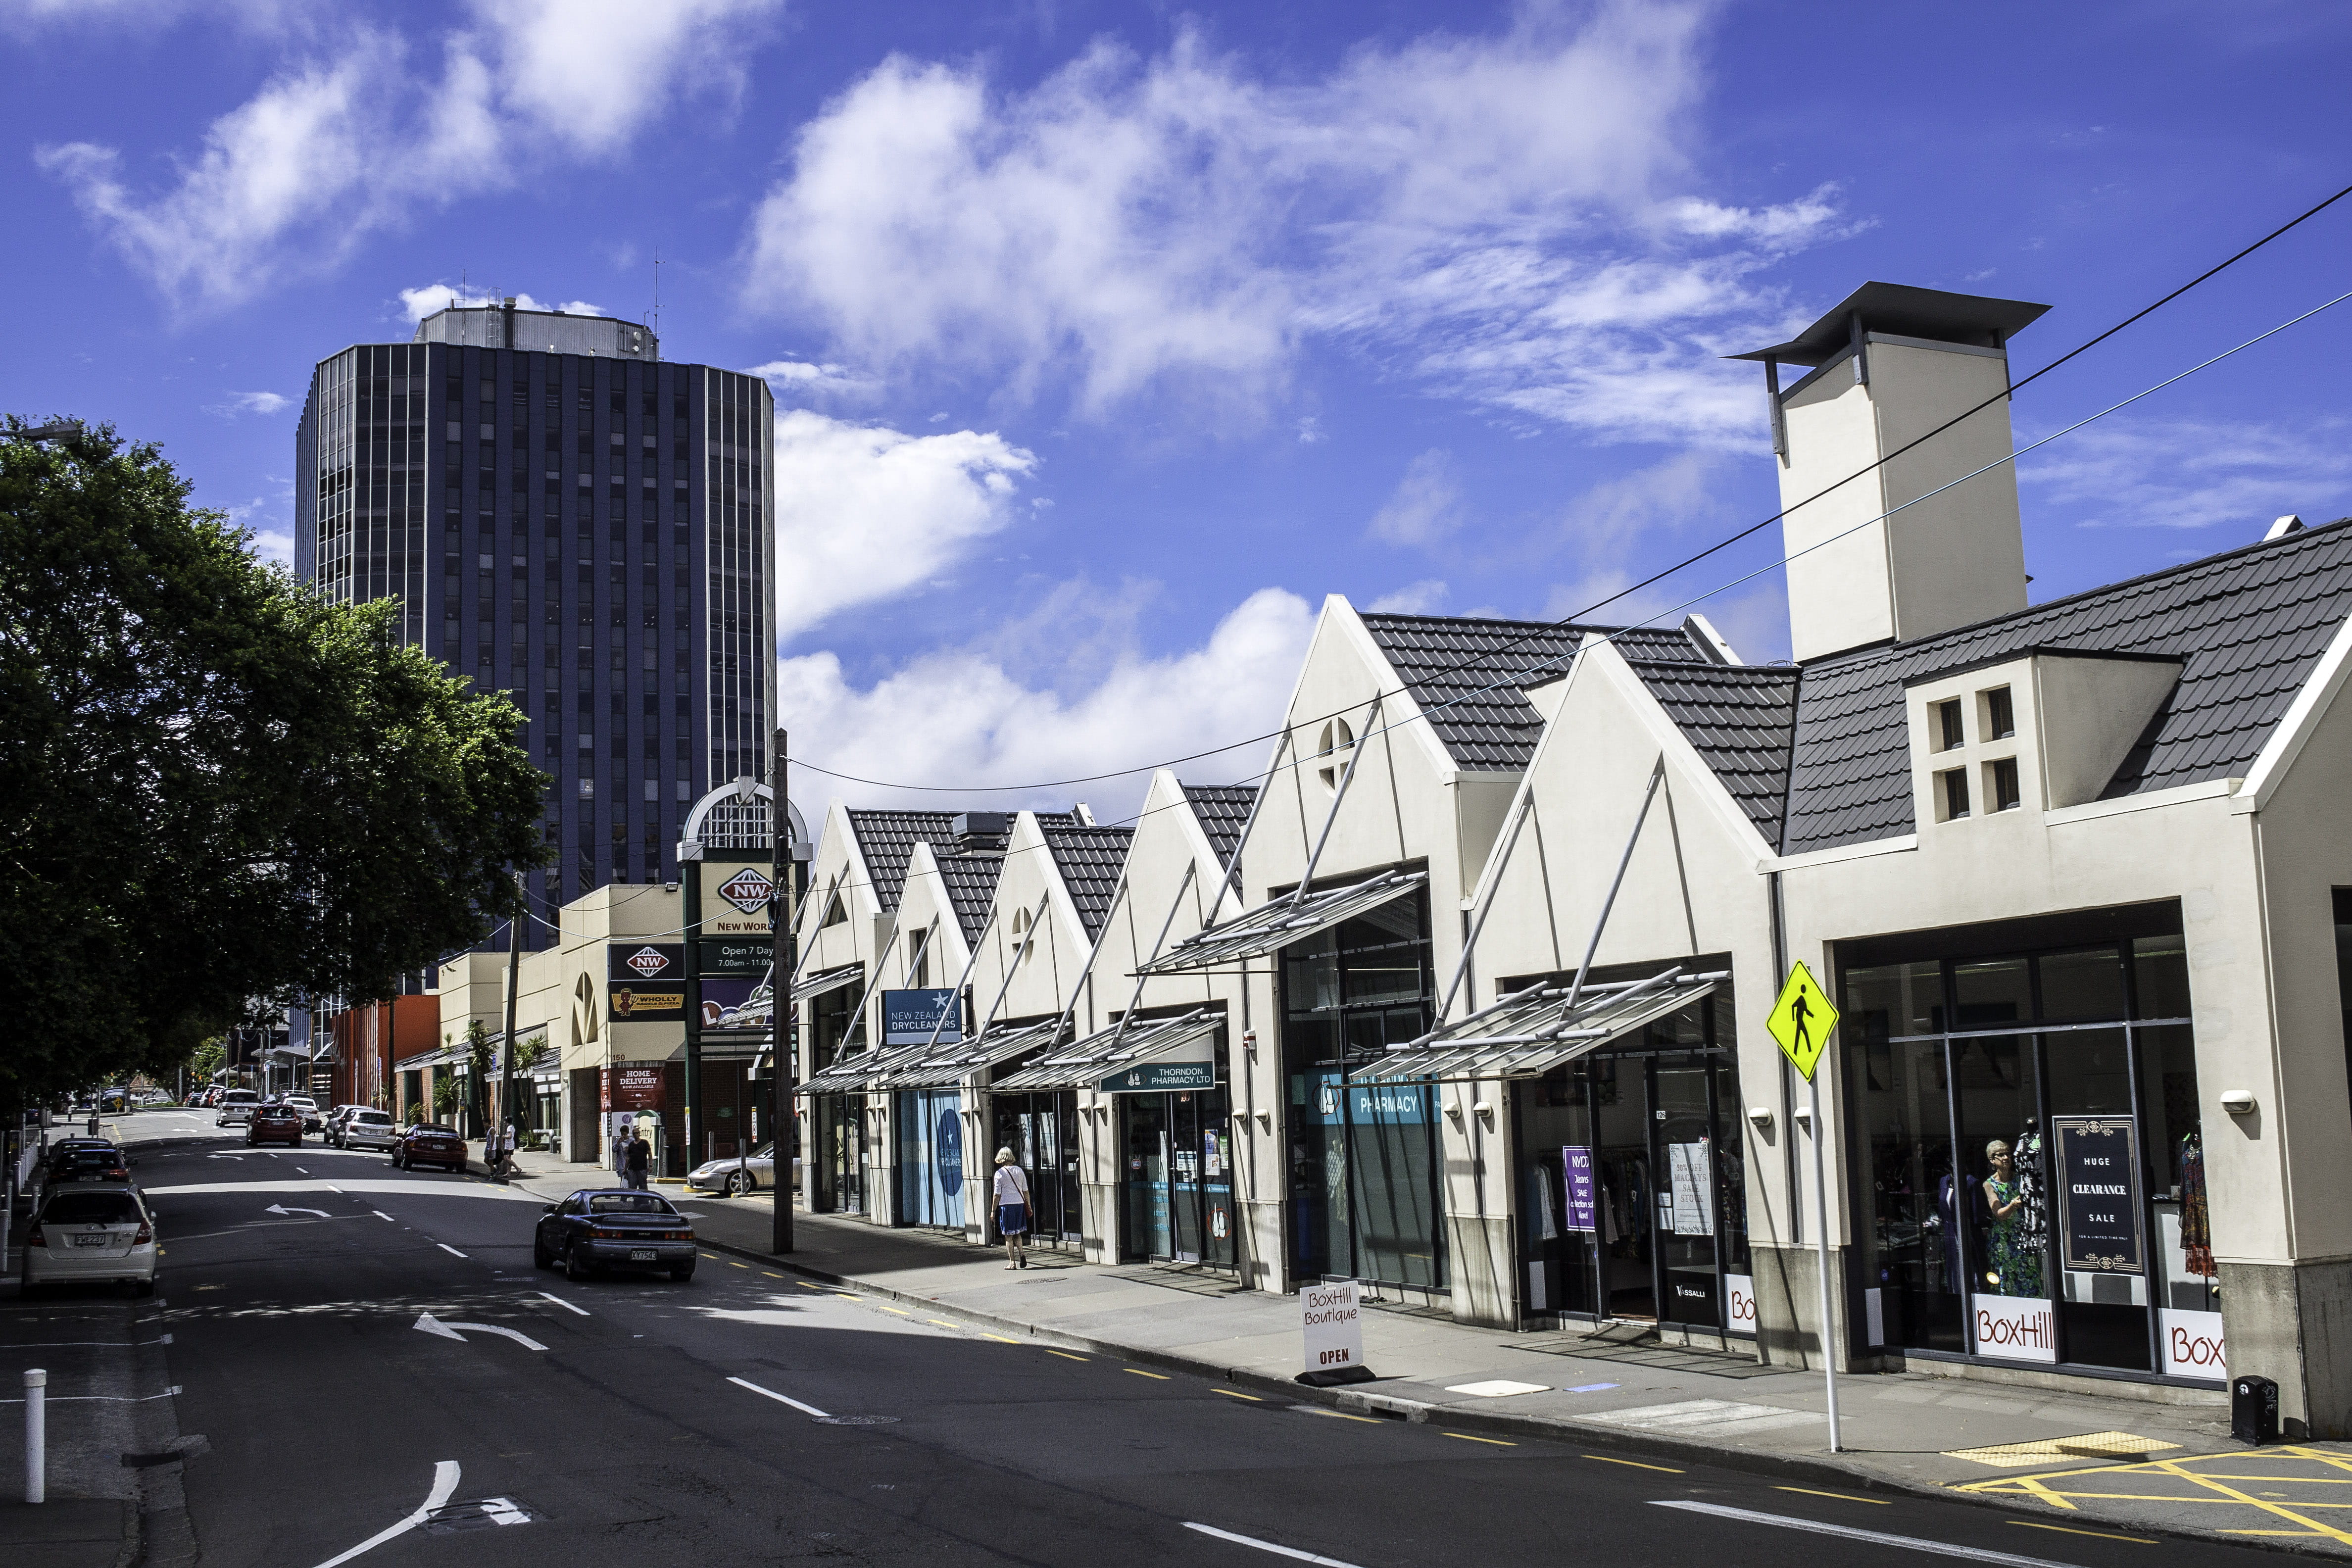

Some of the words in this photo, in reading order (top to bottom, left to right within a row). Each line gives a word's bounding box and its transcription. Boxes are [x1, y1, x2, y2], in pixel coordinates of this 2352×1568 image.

[734, 884, 767, 897] NW
[722, 947, 746, 957] Open
[637, 957, 661, 967] NW
[915, 1011, 955, 1020] ZEALAD
[892, 1021, 956, 1030] DRYCLEANRS
[1151, 1076, 1194, 1084] PHARMACY
[1361, 1096, 1417, 1113] PHARMACY
[640, 1127, 653, 1138] ntry
[1574, 1175, 1589, 1183] Jeans
[2072, 1184, 2126, 1195] CLEARANCE
[1680, 1194, 1703, 1203] STOCK
[1676, 1285, 1705, 1297] VASSALLI
[1309, 1287, 1351, 1308] BoxHill
[1977, 1310, 2054, 1349] BoxHill
[2171, 1327, 2226, 1368] Box
[1320, 1348, 1349, 1365] OPEN
